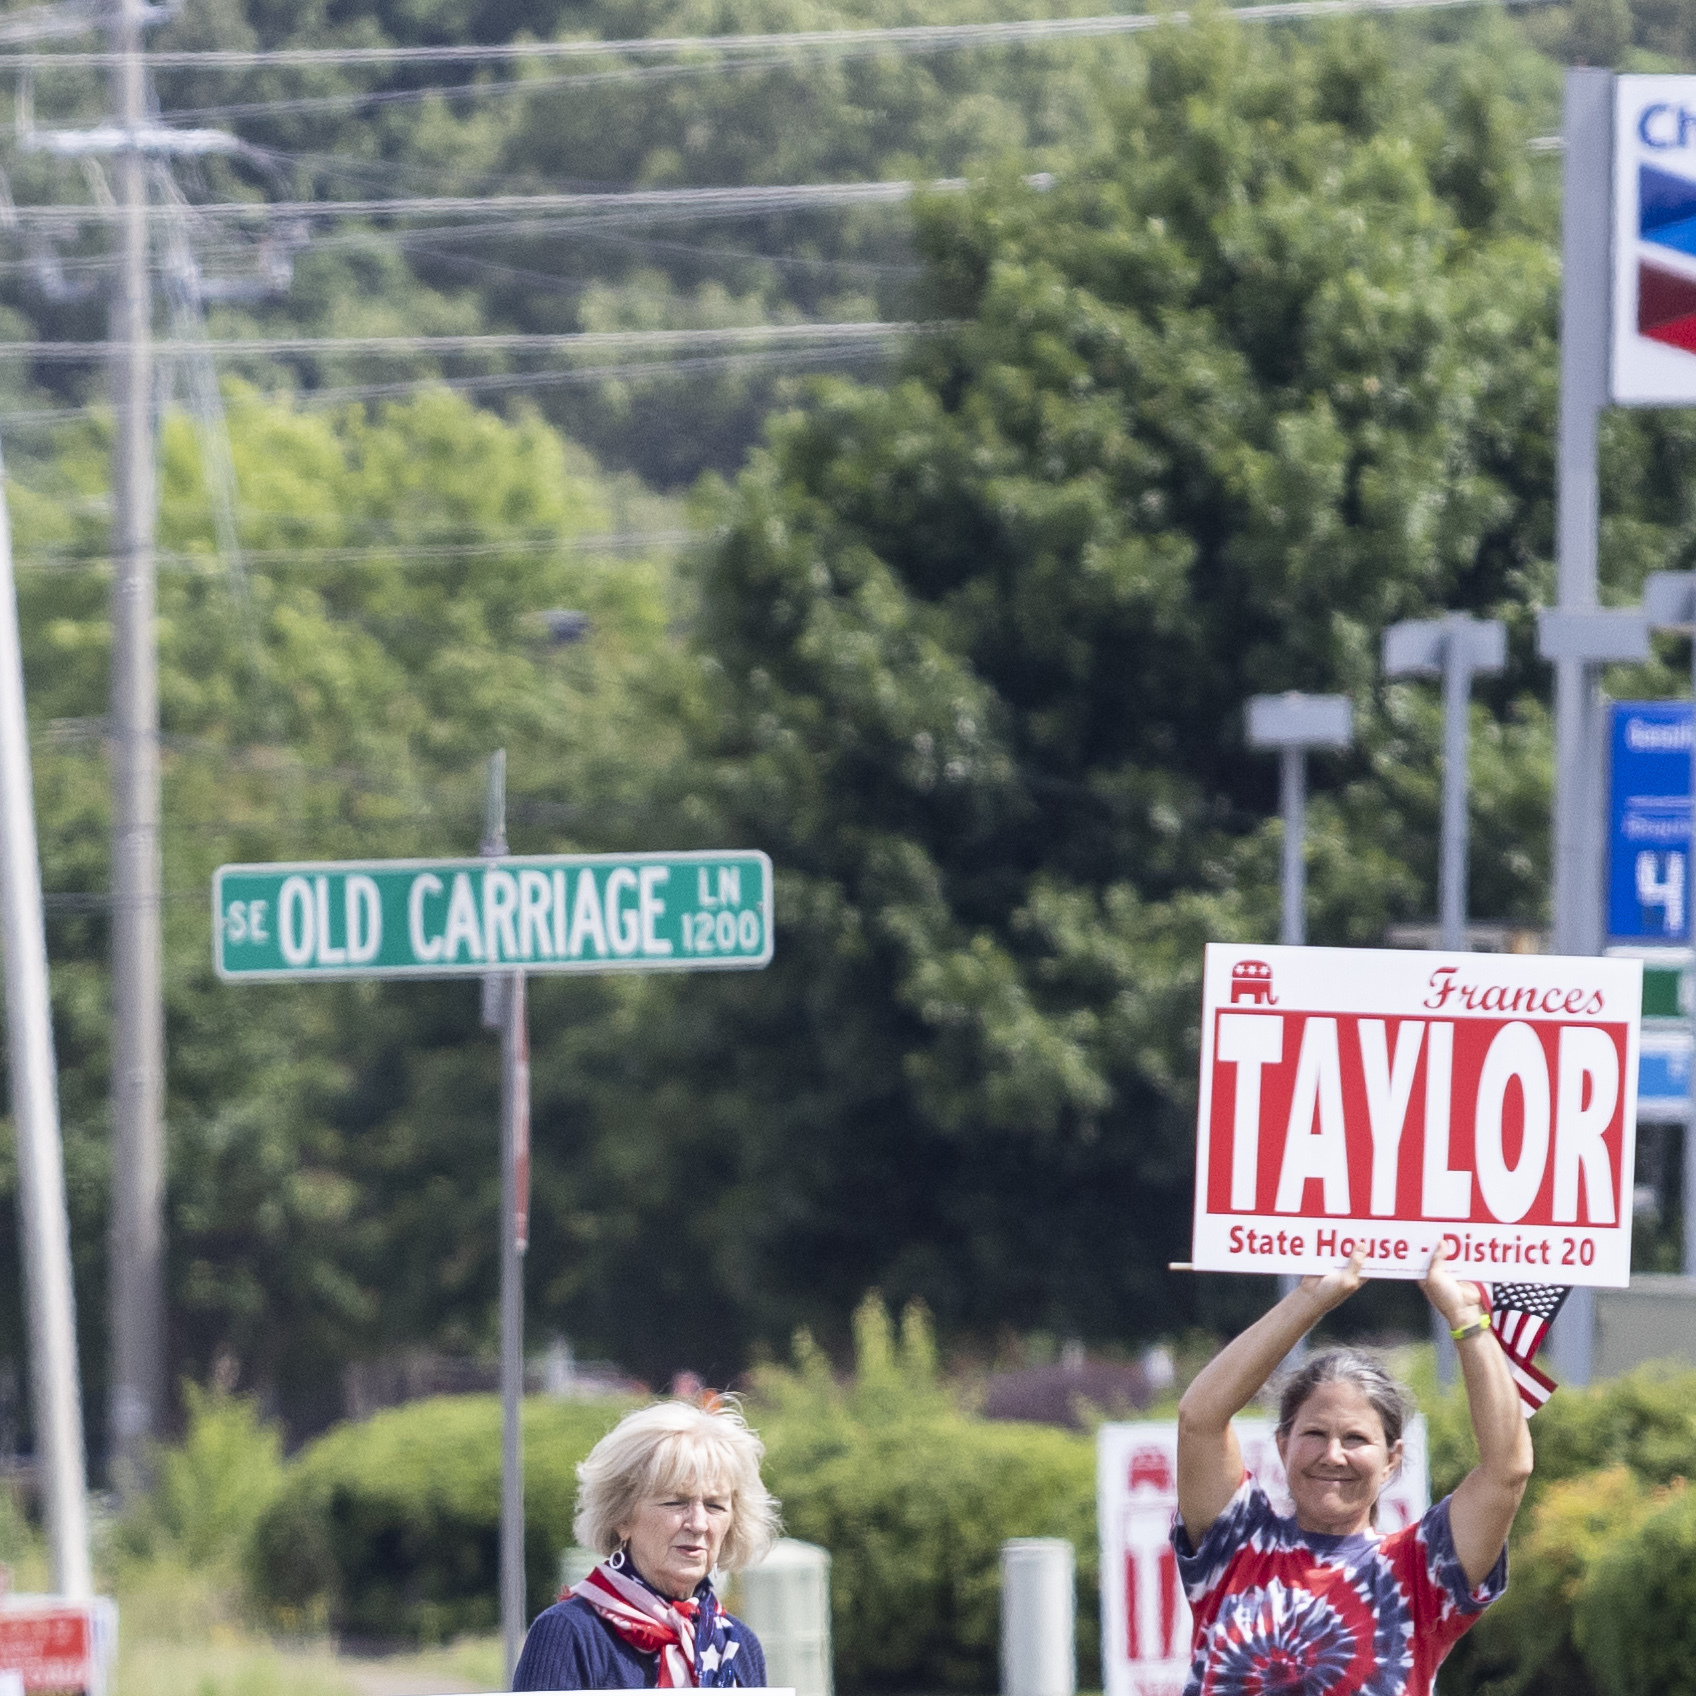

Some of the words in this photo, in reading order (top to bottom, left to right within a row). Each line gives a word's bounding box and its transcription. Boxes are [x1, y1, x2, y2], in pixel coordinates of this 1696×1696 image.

[697, 866, 740, 906] LN
[227, 901, 268, 943] SE
[279, 876, 381, 965] OLD
[408, 866, 672, 960] CARRIAGE
[682, 909, 759, 953] 1200
[1423, 967, 1605, 1013] Frances
[1218, 1013, 1619, 1224] TAYLOR
[1229, 1225, 1304, 1256] State
[1316, 1229, 1408, 1259] House
[1441, 1233, 1551, 1264] District
[1561, 1237, 1596, 1267] 20
